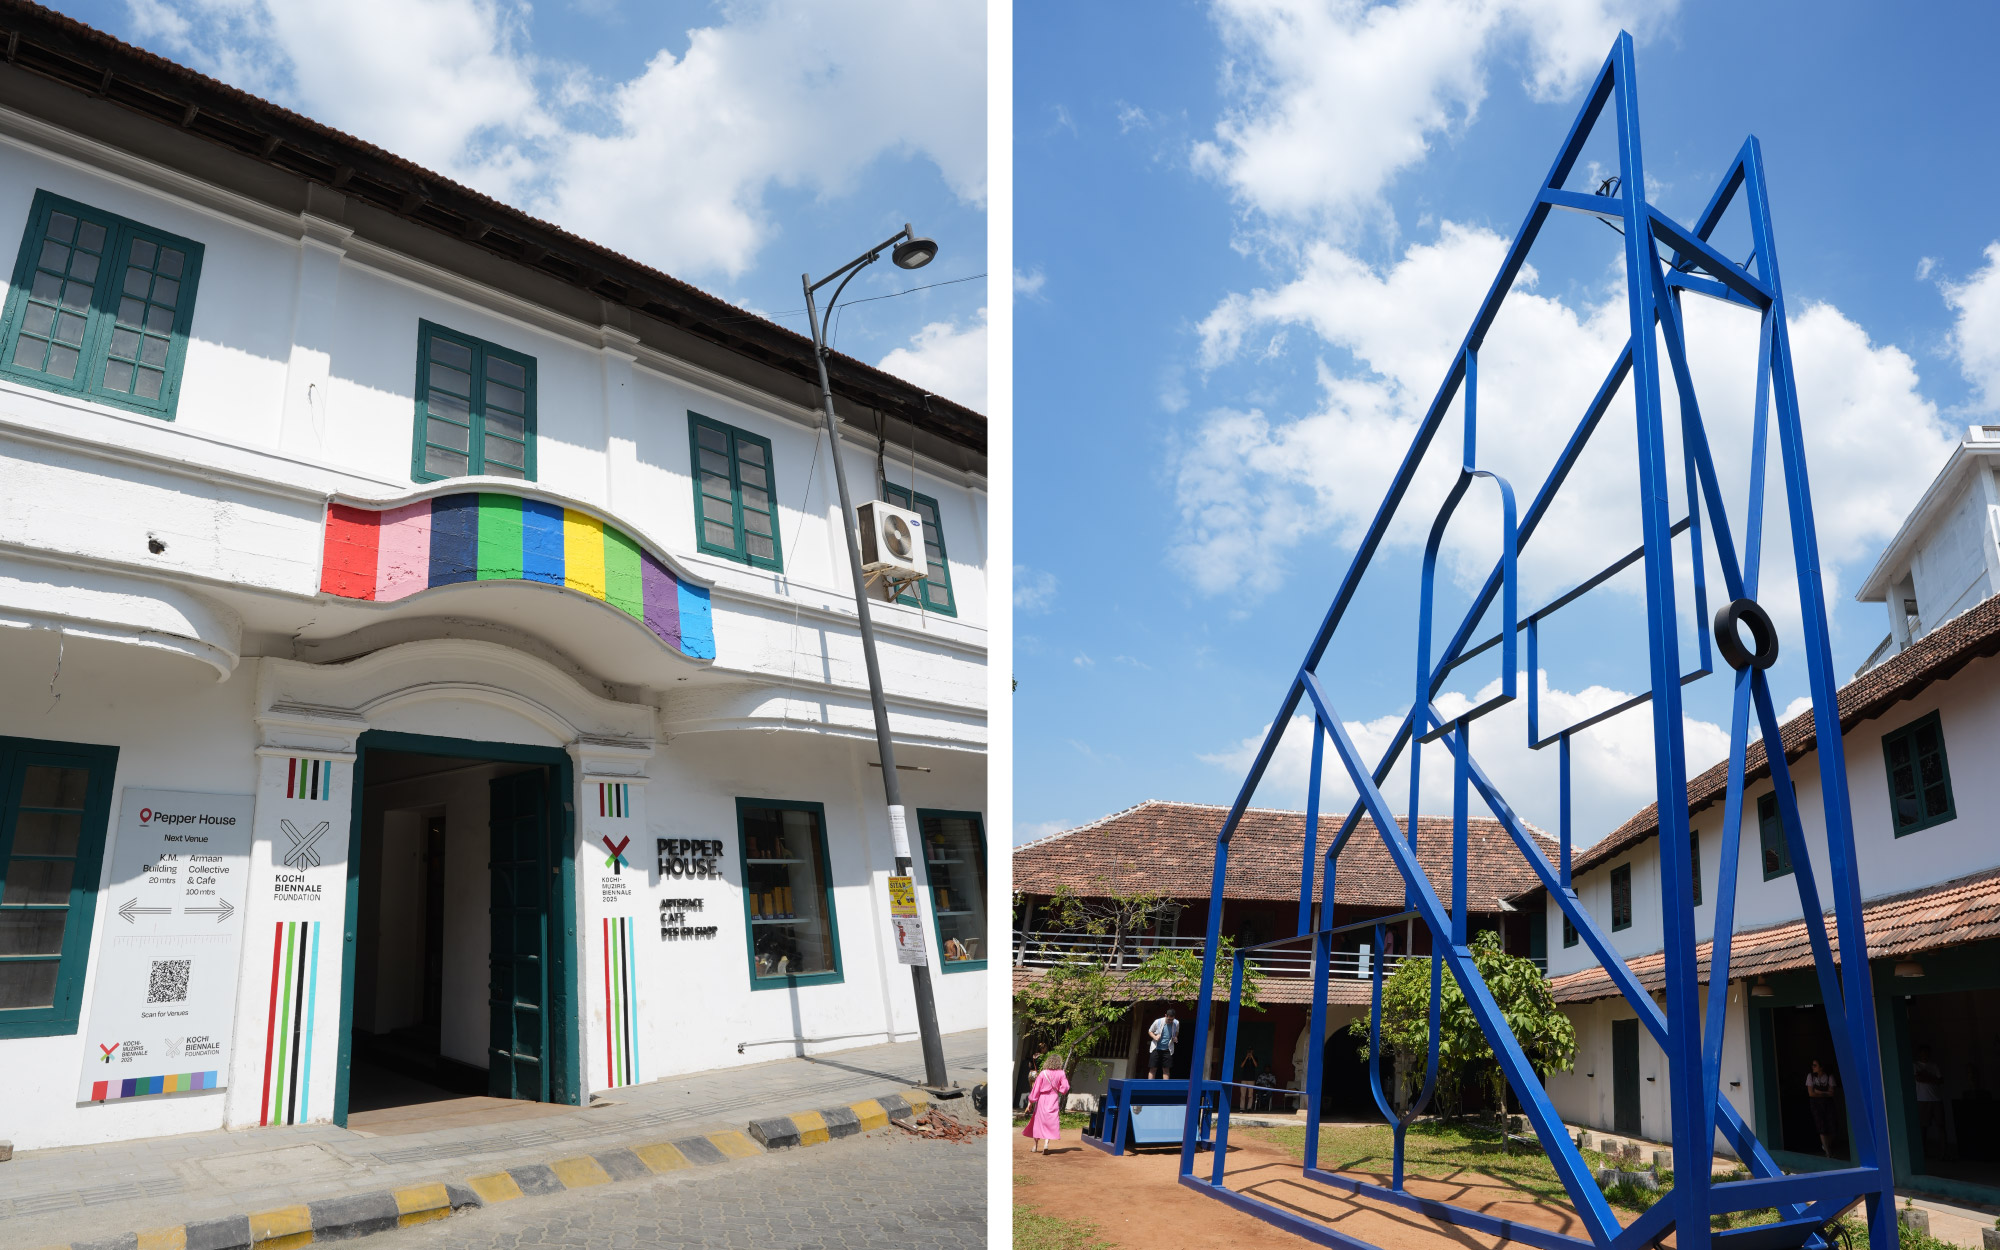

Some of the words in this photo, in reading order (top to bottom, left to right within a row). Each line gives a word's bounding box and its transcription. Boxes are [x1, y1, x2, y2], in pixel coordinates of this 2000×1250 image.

[154, 811, 197, 825] Pepper
[199, 814, 236, 826] House
[164, 834, 183, 842] Next
[657, 838, 724, 857] PEPPER
[160, 853, 178, 862] K.M.
[189, 854, 223, 862] Armaan
[143, 864, 177, 874] Building
[188, 865, 229, 874] Collective
[658, 857, 718, 876] HOUSE
[149, 876, 158, 884] 20
[187, 876, 194, 884] &
[196, 876, 216, 884] Cafe
[275, 874, 305, 882] KOCHI
[186, 888, 199, 896] 100
[200, 888, 215, 896] mtrs
[274, 884, 322, 892] BIENNALE
[273, 893, 321, 901] FOUNDATION
[660, 898, 704, 908] ARTSPACE
[660, 912, 686, 922] CAFE
[694, 925, 718, 936] SHOP
[185, 1042, 220, 1051] BIENNALE
